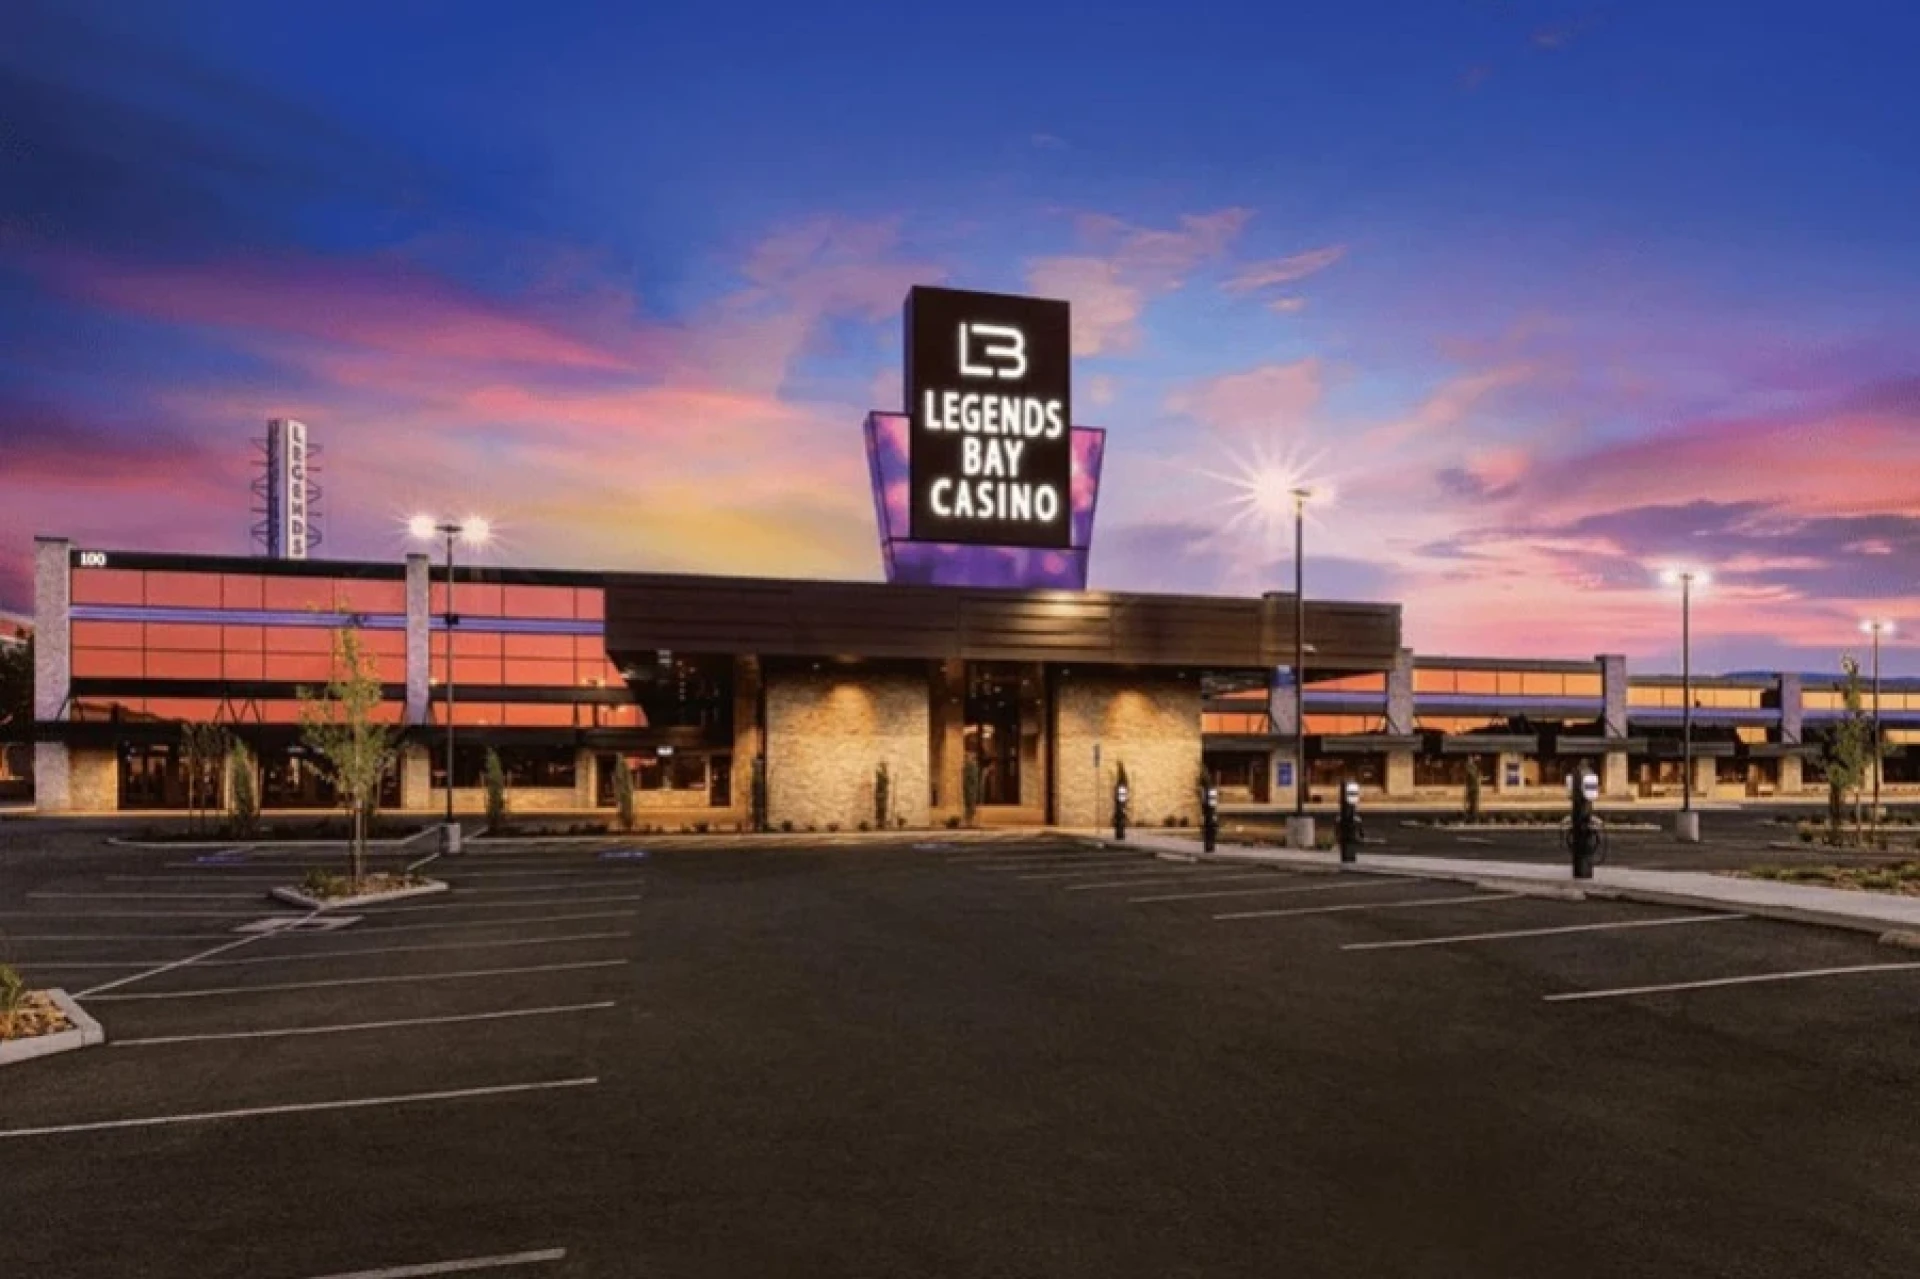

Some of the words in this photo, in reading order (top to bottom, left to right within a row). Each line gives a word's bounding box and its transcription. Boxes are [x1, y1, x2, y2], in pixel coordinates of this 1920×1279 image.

[924, 389, 1063, 438] LEGENDS
[962, 436, 1025, 477] BAY
[292, 425, 304, 555] LEGENDS
[930, 477, 1059, 522] CASINO
[80, 552, 107, 566] 100
